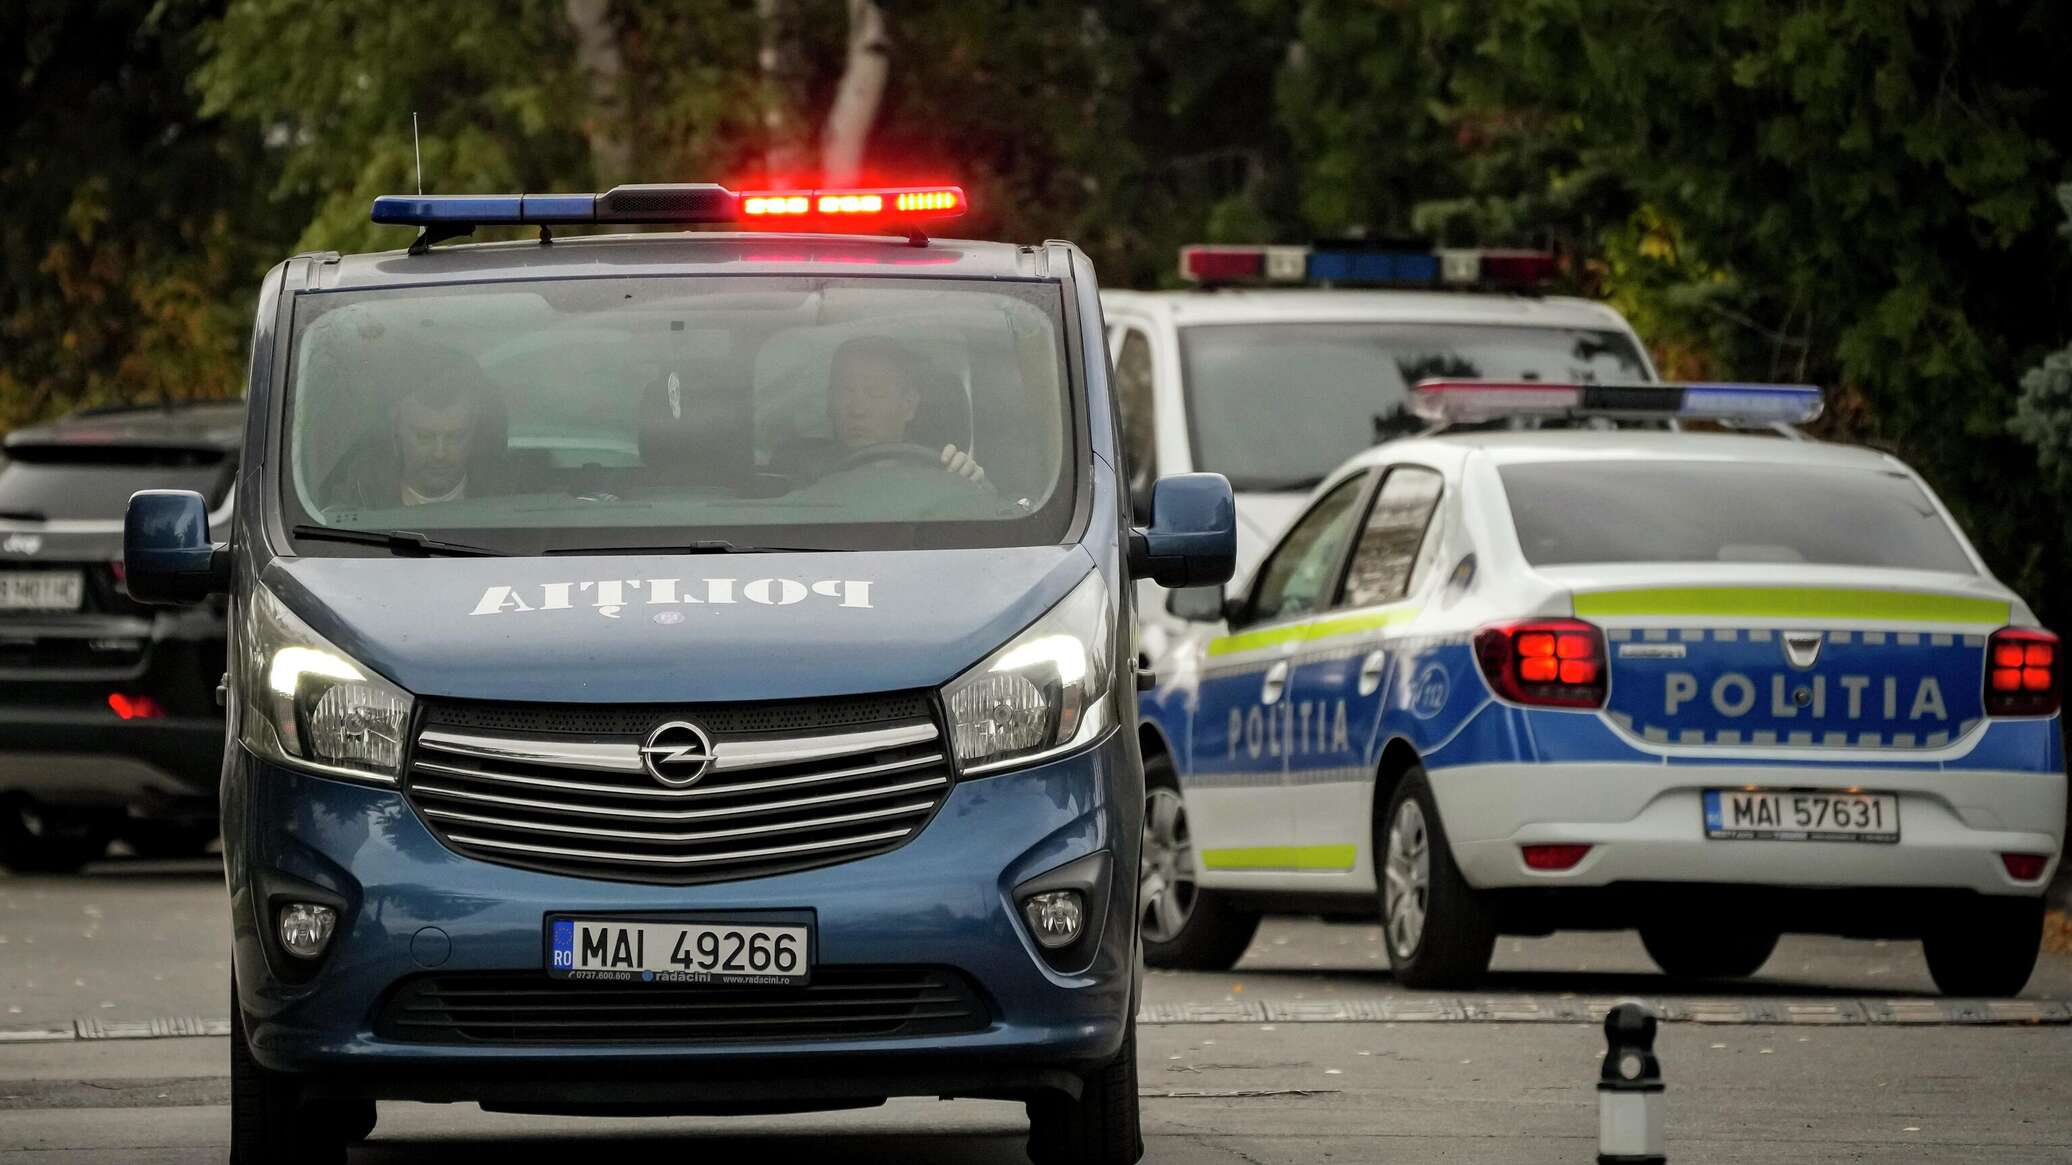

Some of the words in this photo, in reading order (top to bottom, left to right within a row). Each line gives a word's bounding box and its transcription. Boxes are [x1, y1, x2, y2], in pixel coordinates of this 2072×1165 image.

[1664, 672, 1948, 720] POLITIA
[1733, 797, 1782, 827] MAI
[1794, 799, 1882, 829] 57631
[554, 950, 572, 966] RO
[581, 927, 644, 969] MAI
[670, 930, 797, 972] 49266
